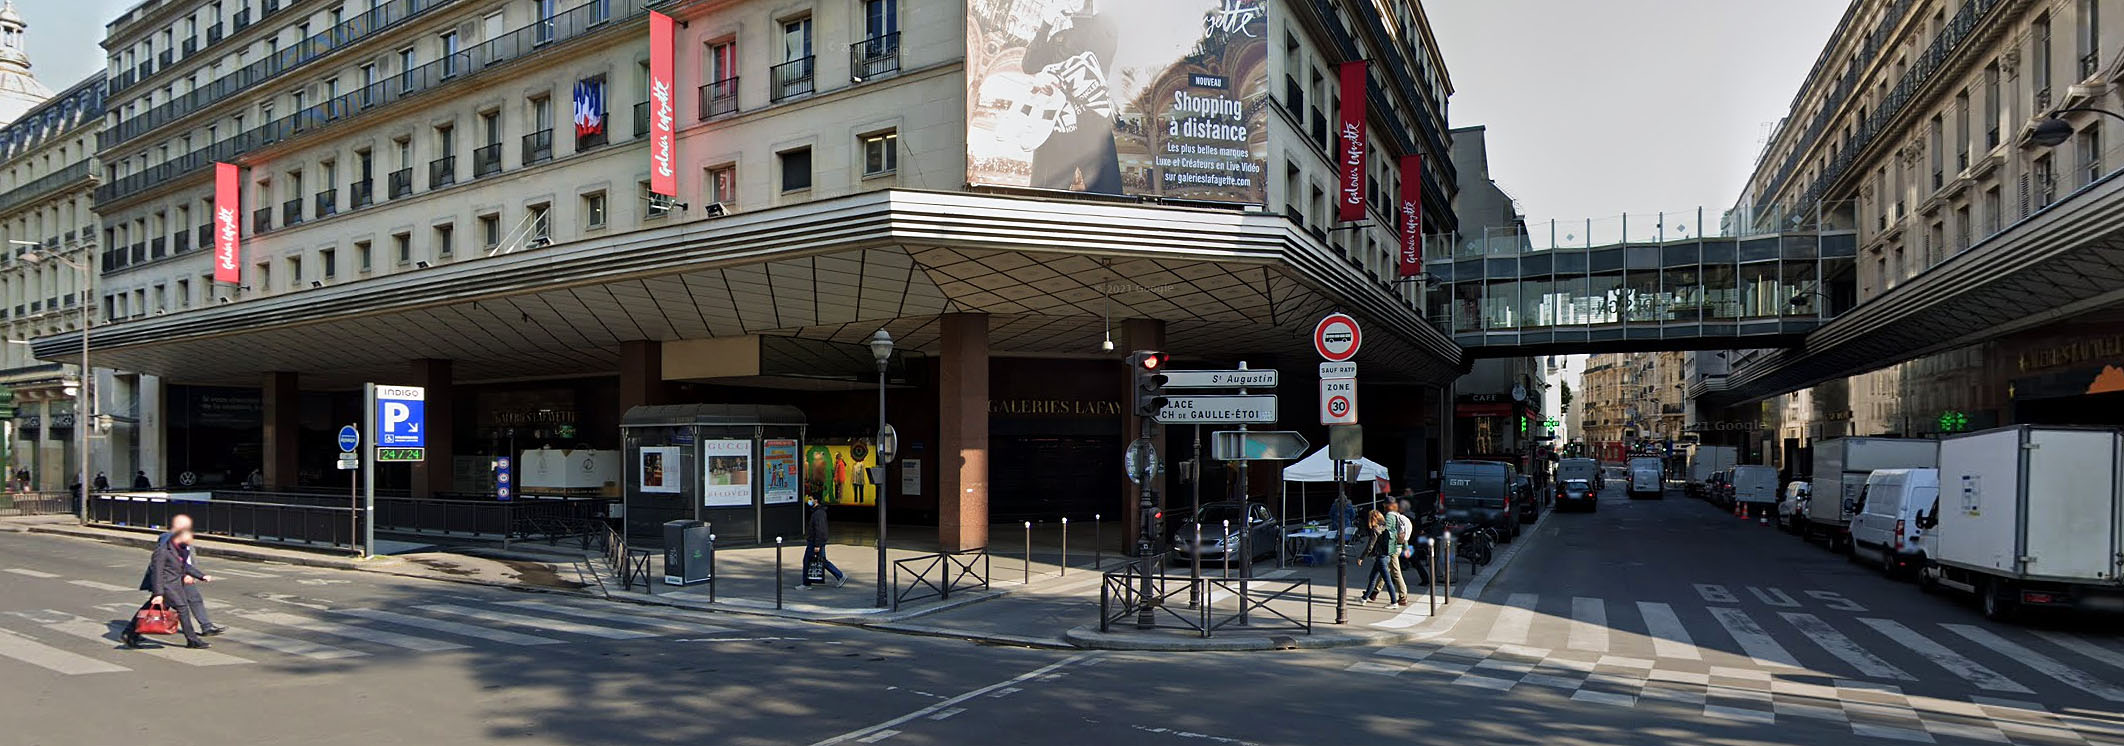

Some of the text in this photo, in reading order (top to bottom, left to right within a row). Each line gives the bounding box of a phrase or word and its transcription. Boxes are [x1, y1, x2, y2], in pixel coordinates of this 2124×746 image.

[1195, 76, 1222, 87] NOUVEAU
[1174, 91, 1242, 121] Shopping
[1170, 116, 1247, 142] à distance
[1167, 142, 1249, 158] Les plus belles marques
[1155, 156, 1260, 173] Luxe et Créateurs en Live Vidéo
[1165, 172, 1251, 187] sur galerieslafayette.com
[1228, 375, 1274, 385] Augustin
[988, 399, 1070, 415] GALERIES
[1168, 400, 1193, 409] LACE
[1332, 401, 1346, 412] 30
[384, 402, 410, 433] P
[708, 442, 748, 450] GUCCI
[1694, 583, 1871, 612] BUS
